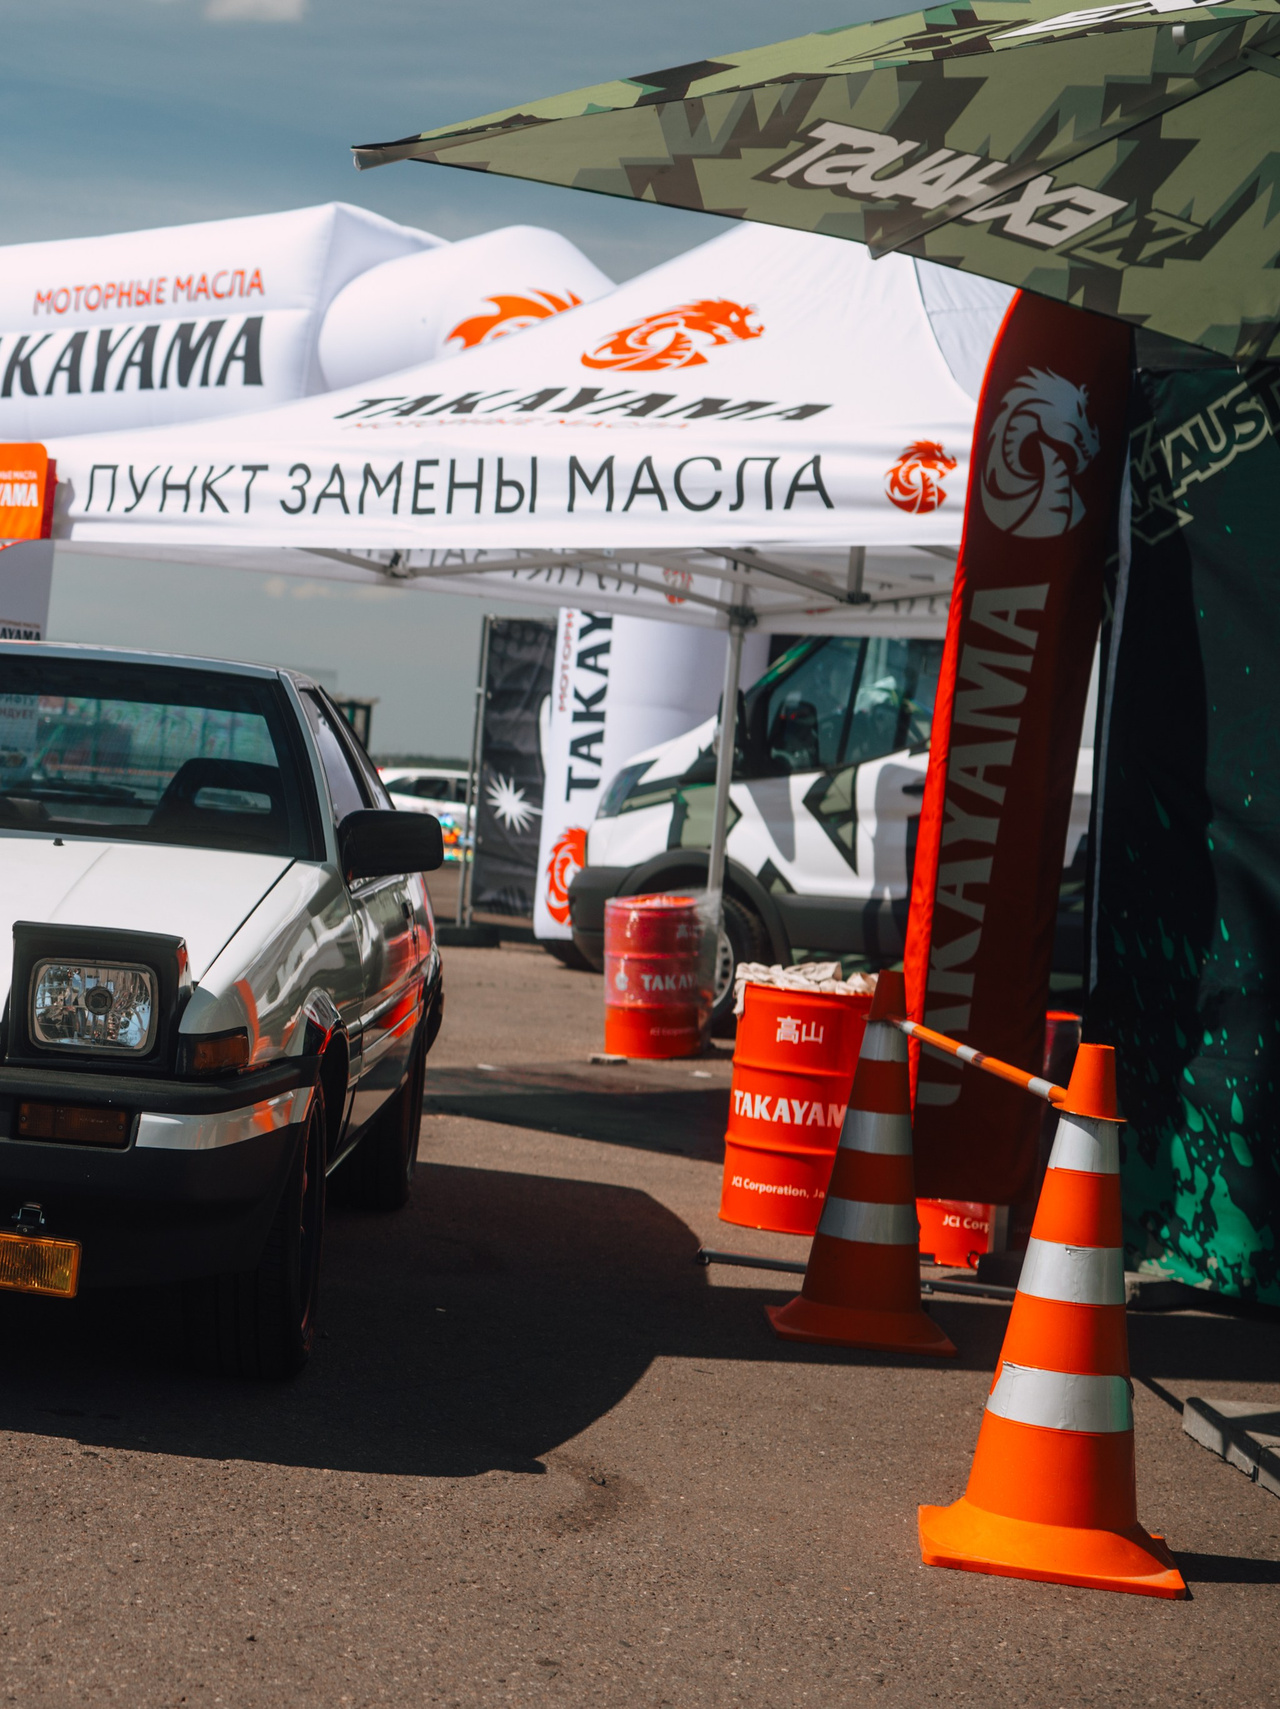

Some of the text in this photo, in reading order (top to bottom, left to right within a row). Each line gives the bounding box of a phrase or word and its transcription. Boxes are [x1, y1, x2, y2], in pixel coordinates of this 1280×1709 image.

[33, 268, 264, 316] МОТОРНЫЕ МАСЛА
[333, 386, 833, 421] TAKAYAMA
[84, 454, 835, 515] ПУНКТ ЗАМЕНЫ МАСЛА
[565, 611, 613, 802] TAKAY
[641, 973, 695, 992] TAKAY
[776, 1015, 824, 1045] 高山
[734, 1089, 848, 1129] TAKAYAM
[743, 1178, 809, 1199] Corporation,
[942, 1213, 960, 1228] JCI
